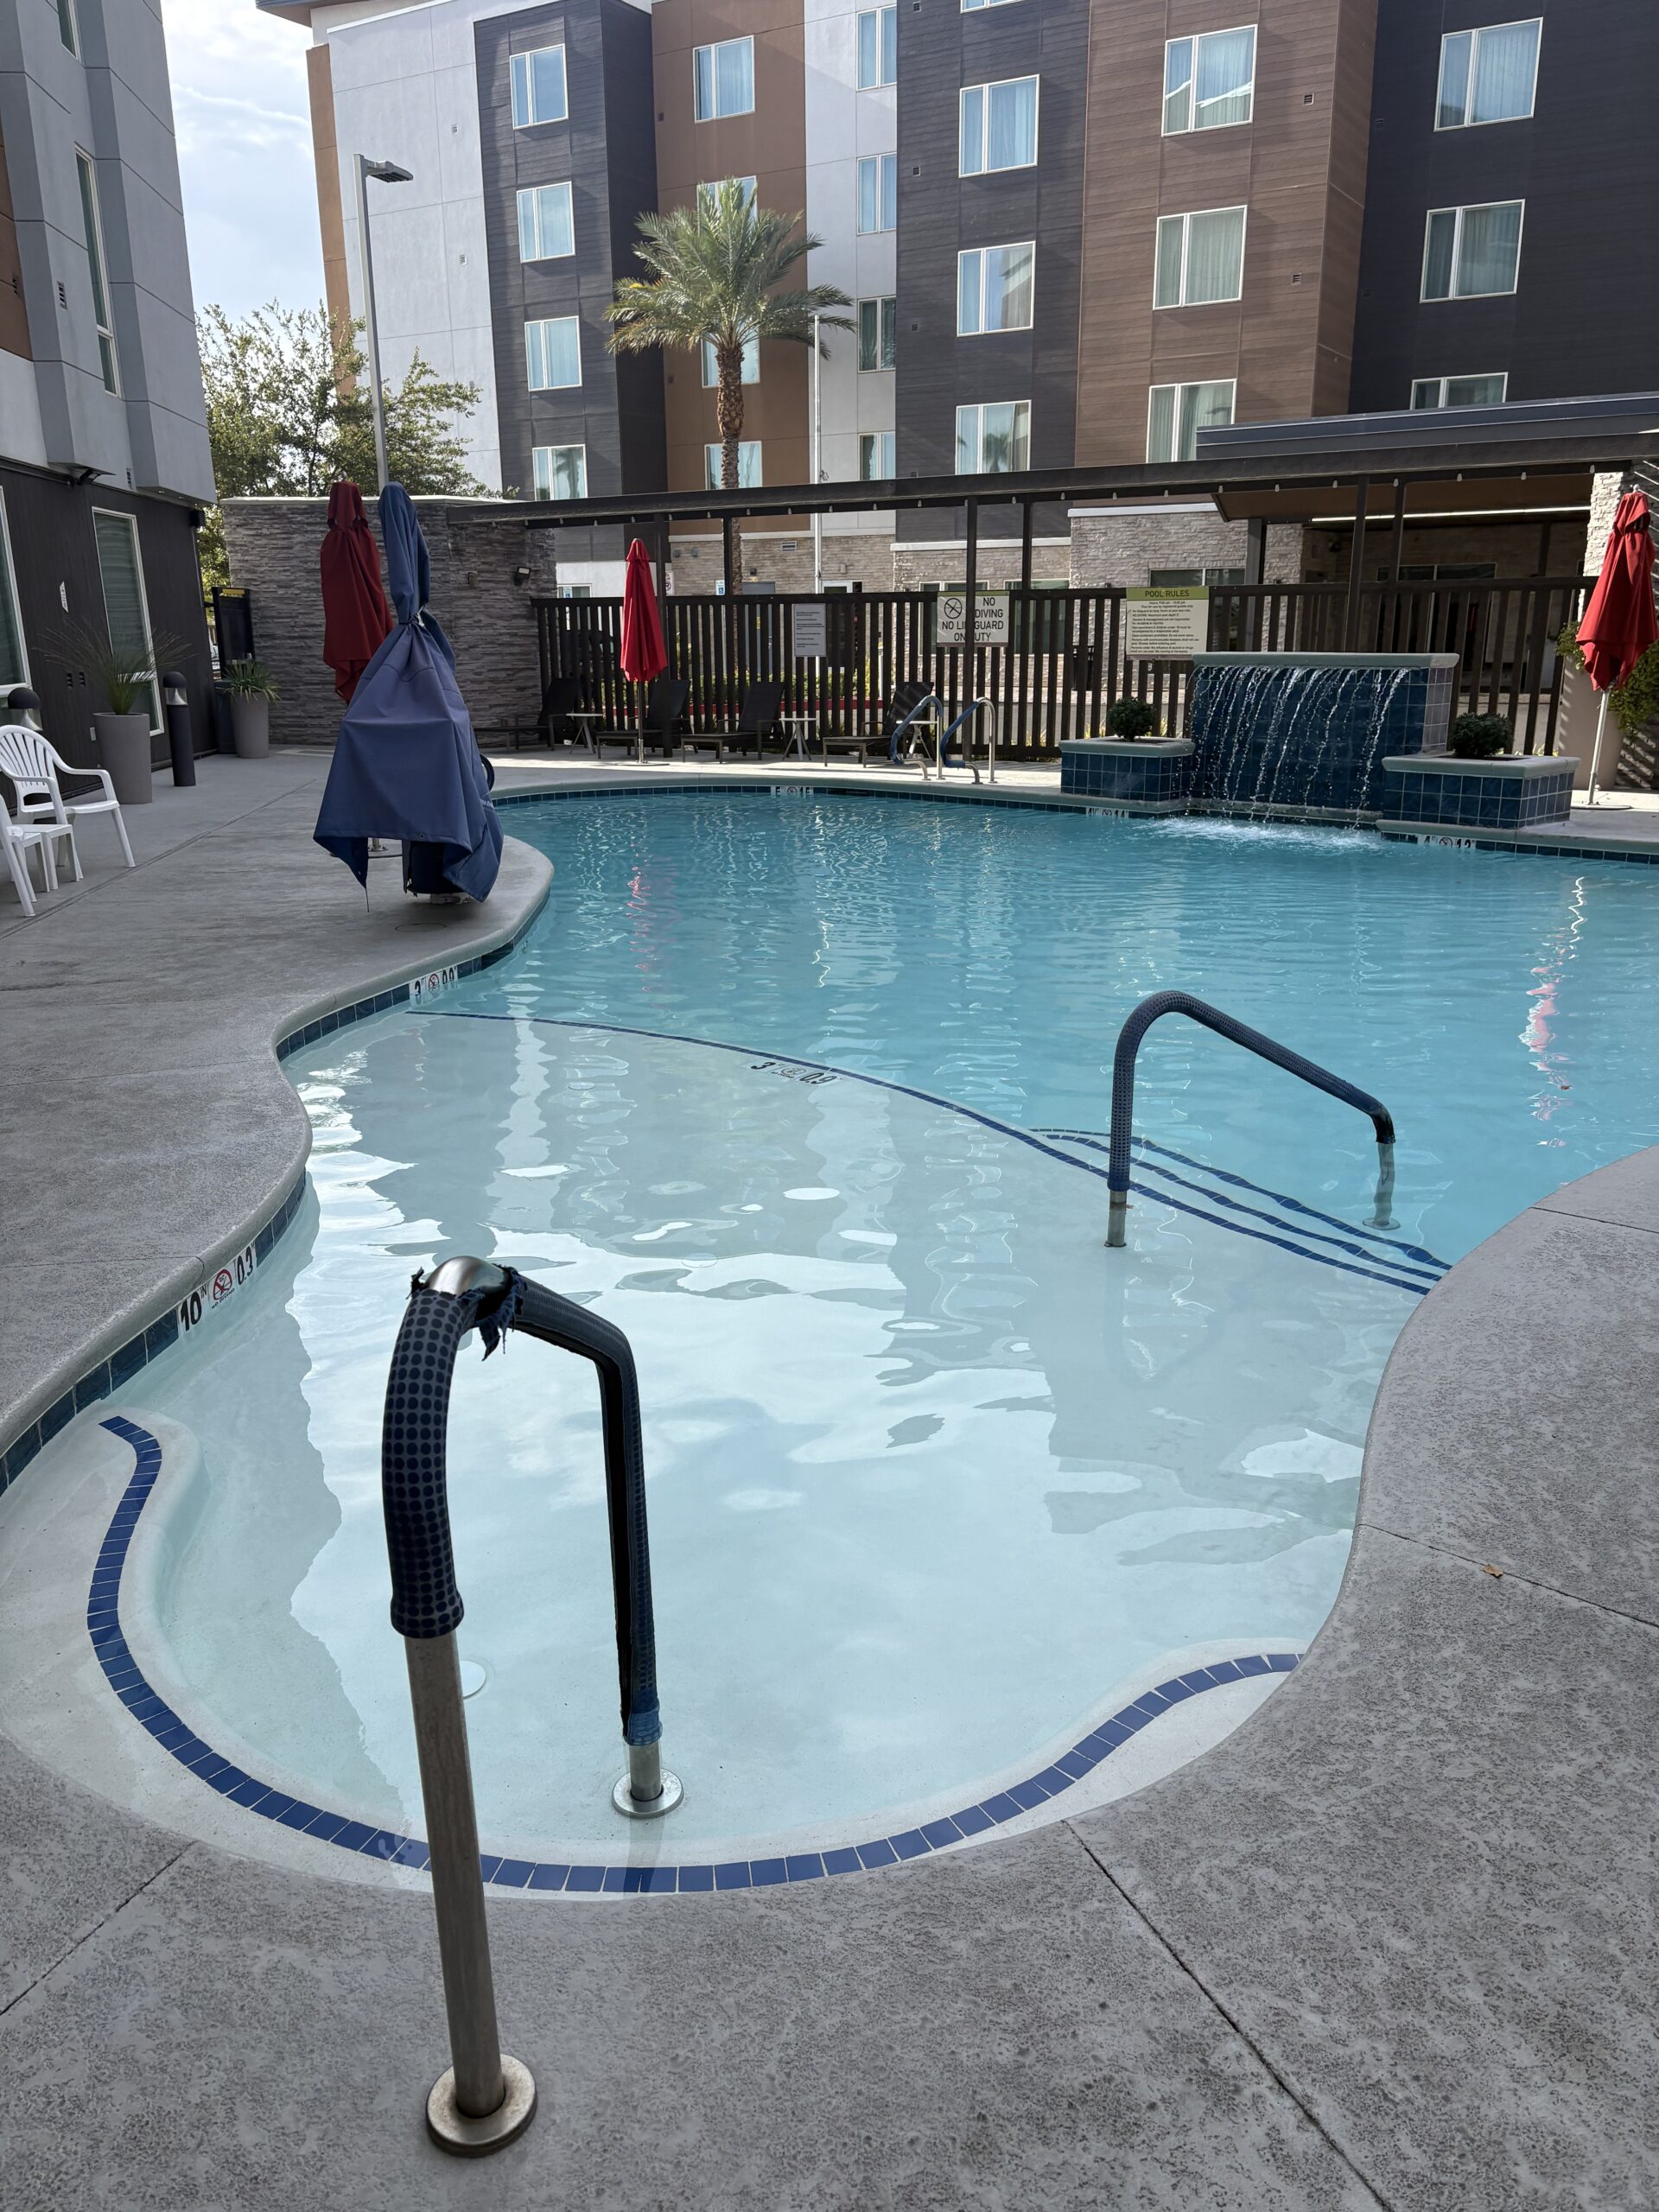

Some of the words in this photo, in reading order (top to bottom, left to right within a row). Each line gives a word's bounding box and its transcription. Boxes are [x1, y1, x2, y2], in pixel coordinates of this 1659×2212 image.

[982, 597, 995, 606] NO
[975, 609, 1003, 618] DIVING
[954, 632, 966, 641] ON
[974, 632, 991, 641] UTY
[799, 1072, 837, 1084] 0.9
[238, 1246, 253, 1286] 0.3
[212, 1301, 219, 1310] NO
[219, 1287, 235, 1304] DIVING
[181, 1291, 202, 1332] 10
